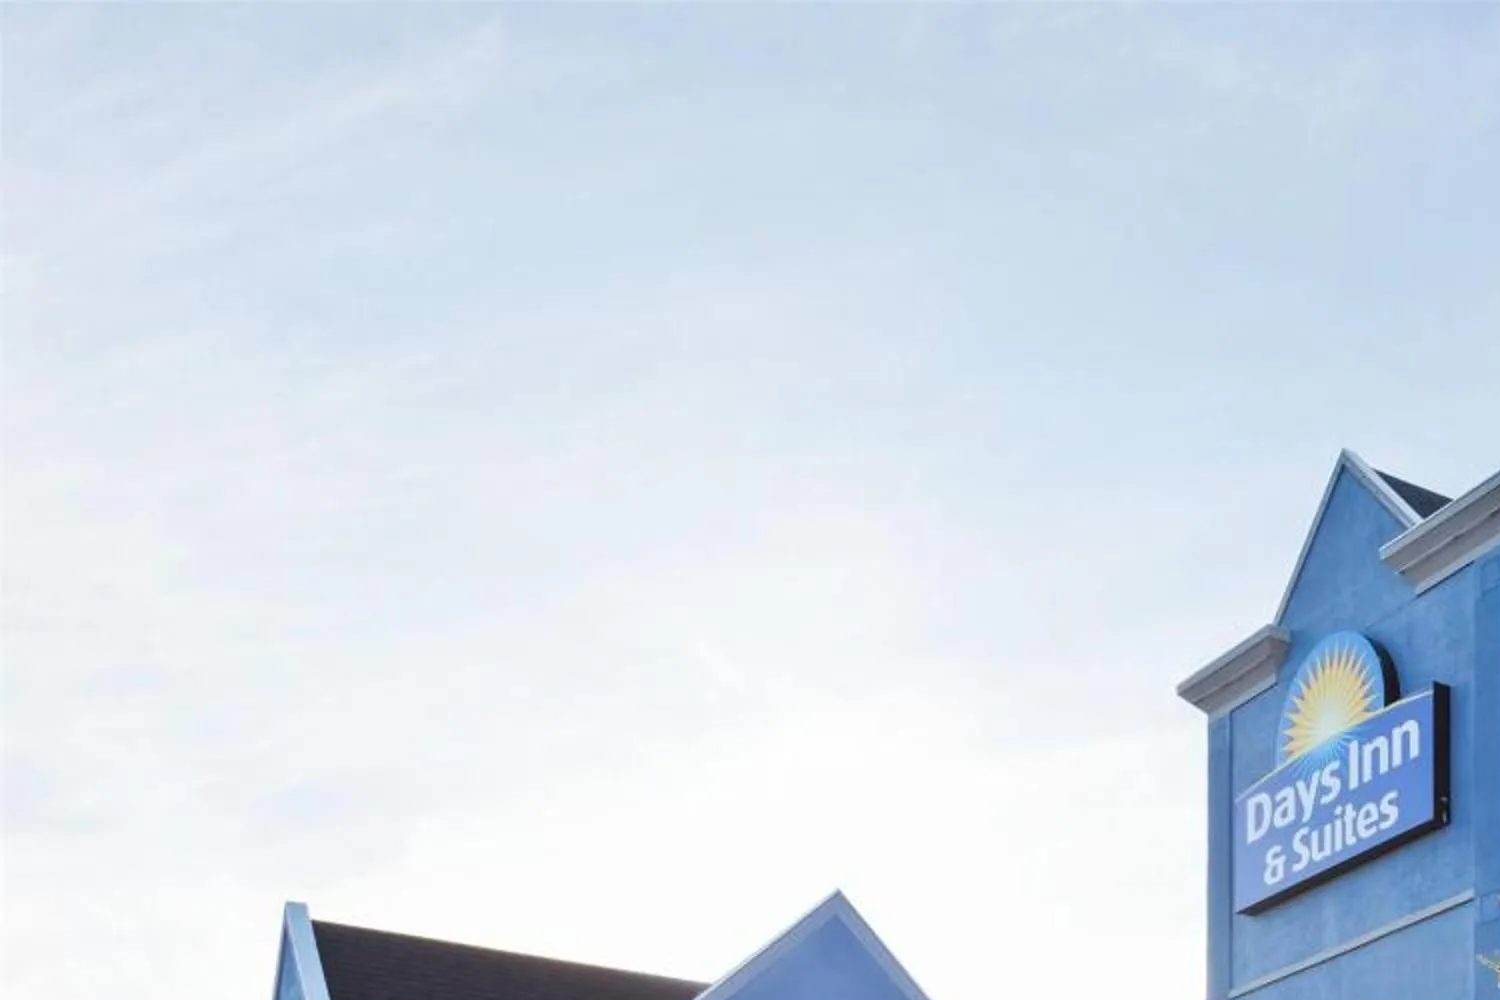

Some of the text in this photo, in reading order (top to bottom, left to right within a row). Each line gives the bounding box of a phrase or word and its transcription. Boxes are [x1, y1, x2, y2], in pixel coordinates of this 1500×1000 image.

[1247, 719, 1420, 843] Days Inn
[1263, 790, 1399, 885] & Suites
